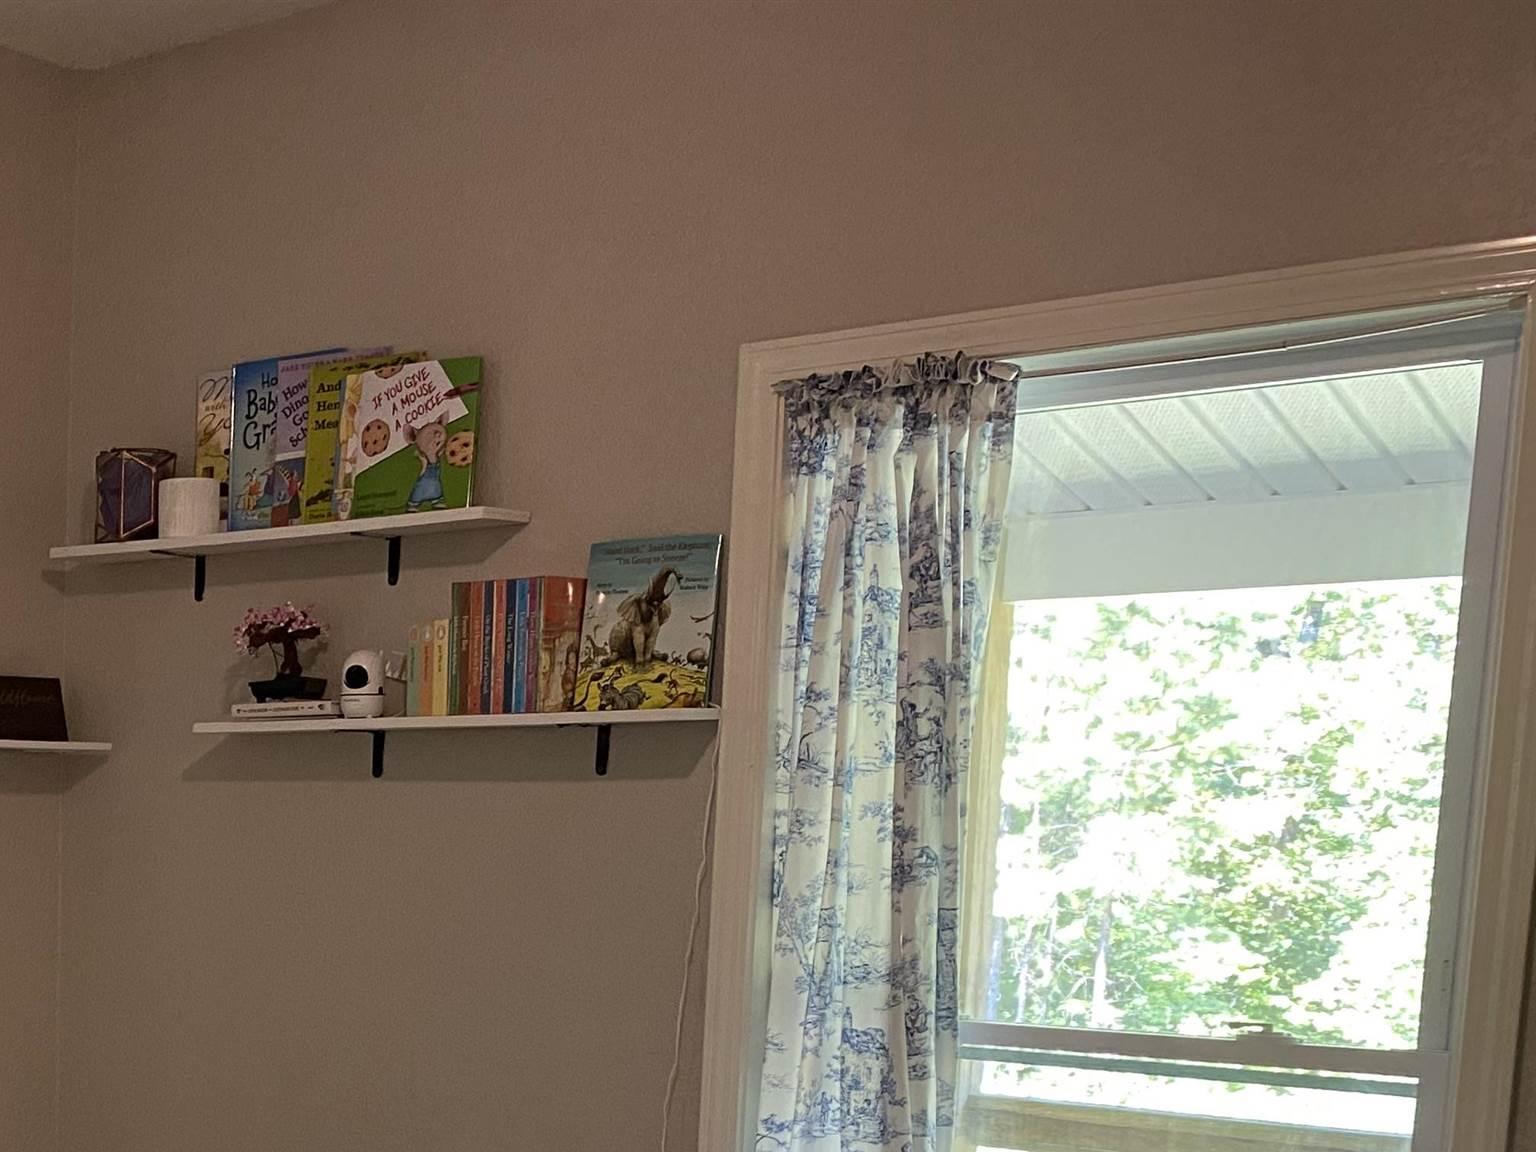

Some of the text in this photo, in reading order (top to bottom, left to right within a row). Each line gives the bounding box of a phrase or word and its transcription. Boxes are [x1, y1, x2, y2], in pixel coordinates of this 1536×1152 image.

[261, 372, 278, 388] Ho
[316, 380, 341, 393] And
[372, 366, 430, 410] IF YOU GIVE
[245, 389, 278, 420] Bab
[282, 395, 309, 419] Dino
[317, 401, 340, 411] Hen
[392, 381, 436, 415] A MOUSE
[396, 392, 444, 432] A COOKIE
[314, 419, 338, 431] Mea
[289, 427, 308, 447] Sch
